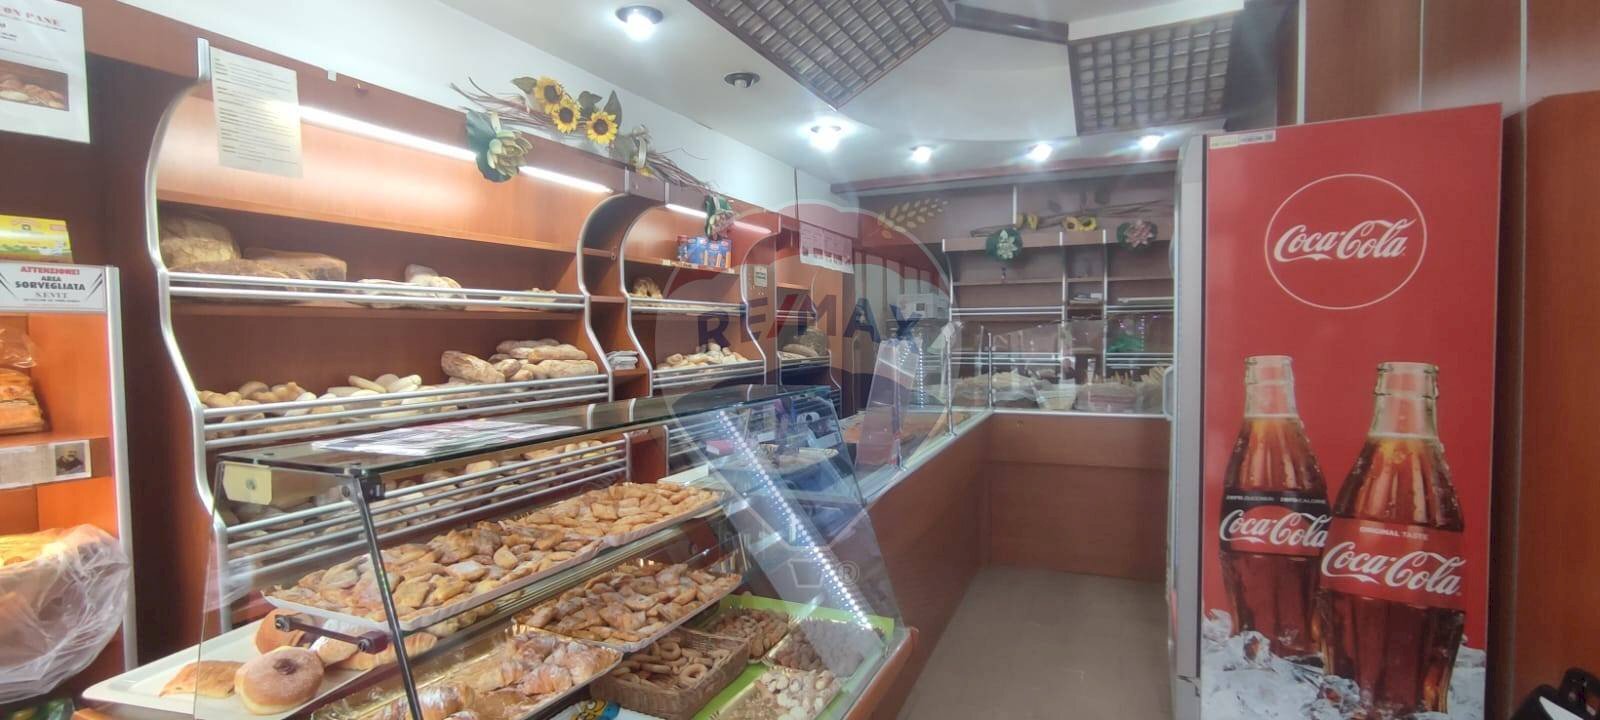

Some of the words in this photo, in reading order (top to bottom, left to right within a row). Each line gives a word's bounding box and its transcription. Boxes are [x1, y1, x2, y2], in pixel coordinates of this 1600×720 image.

[1274, 218, 1417, 262] Coca-Cola
[15, 281, 86, 291] SORVEGLIATA
[20, 266, 80, 275] ATTENZIONE!
[1219, 509, 1333, 548] Coca-Cola
[1321, 541, 1467, 595] Coca-Cola
